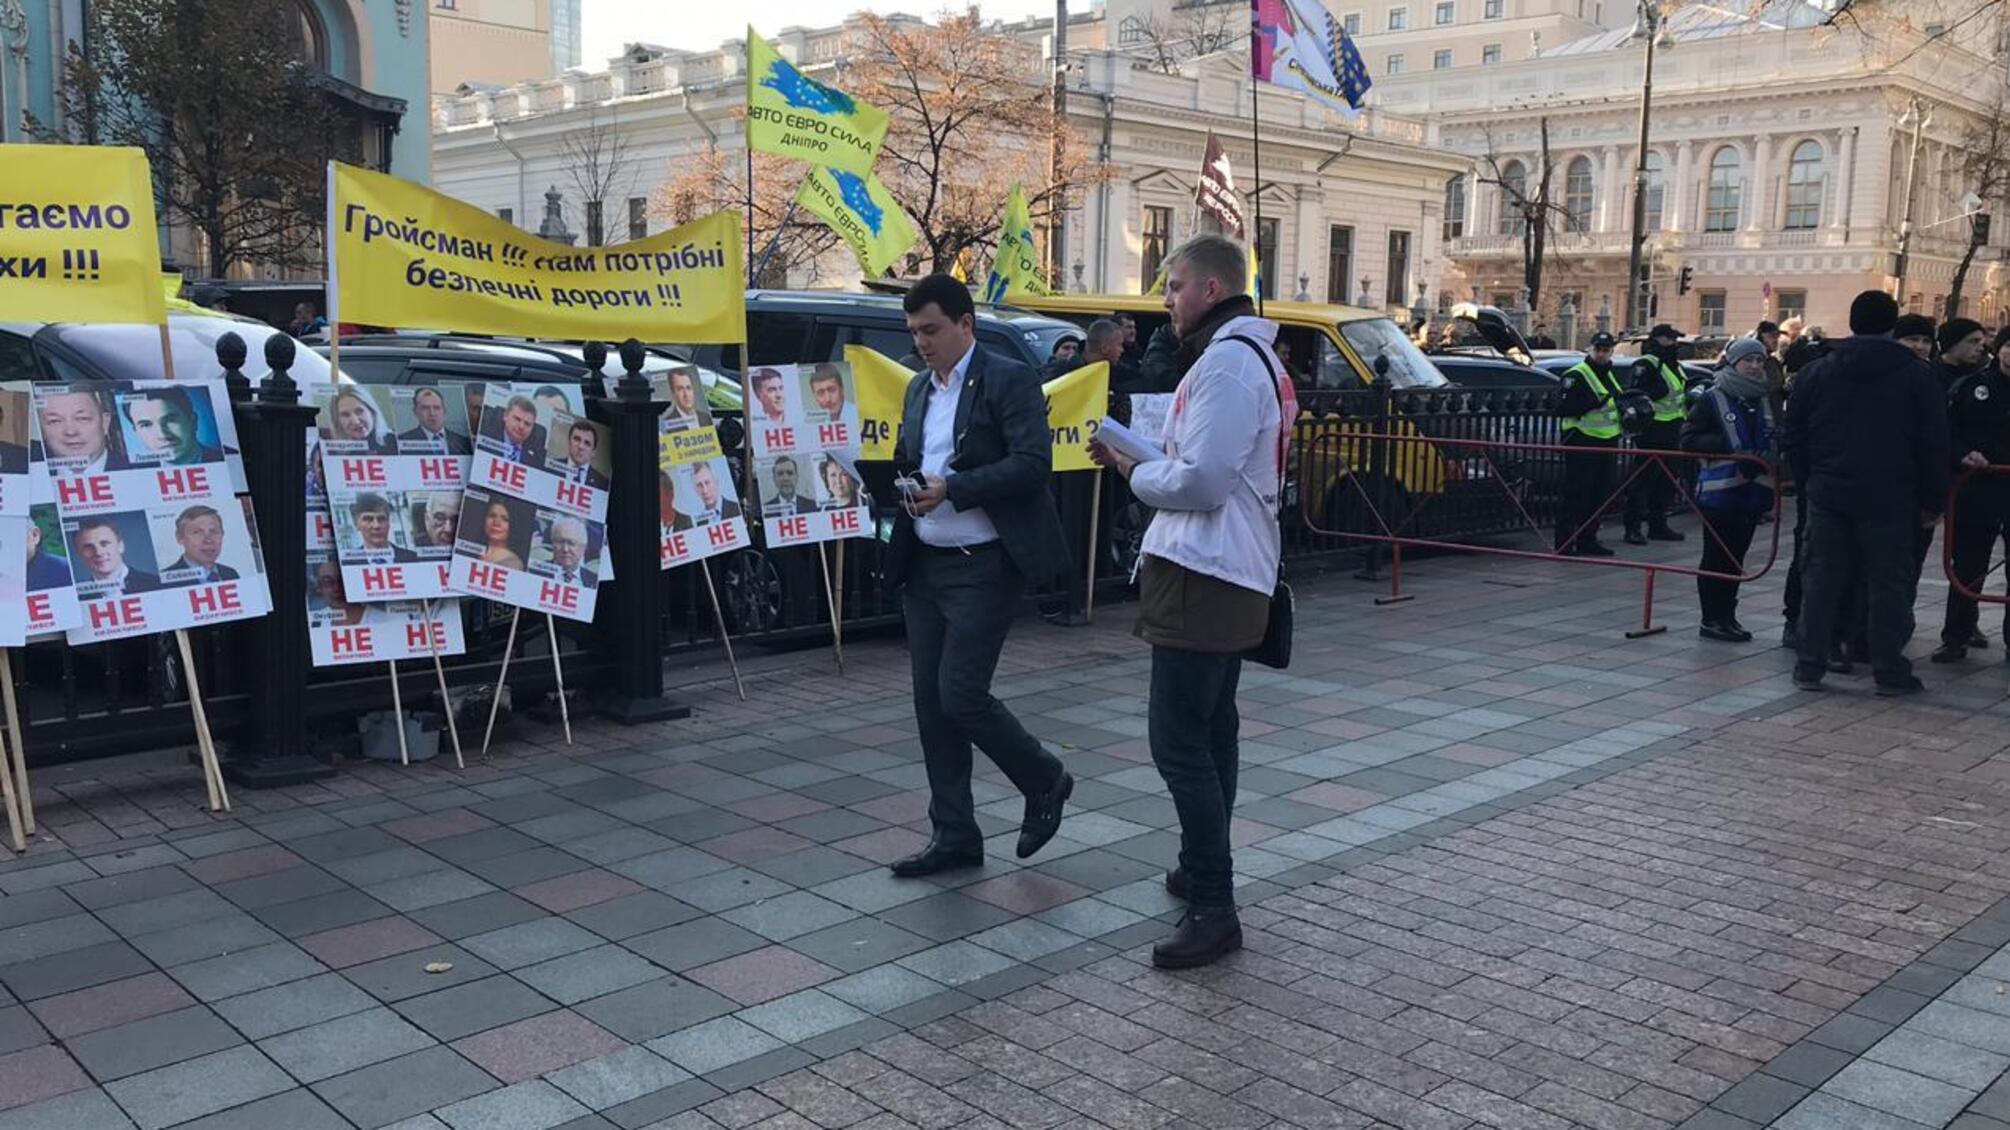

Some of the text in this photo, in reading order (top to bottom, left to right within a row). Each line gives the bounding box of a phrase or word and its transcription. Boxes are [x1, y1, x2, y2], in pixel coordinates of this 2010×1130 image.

[780, 132, 829, 152] ДНІПРО
[786, 114, 827, 135] ЄВРО
[830, 125, 872, 155] СИЛА
[345, 203, 493, 264] Гройсман
[502, 243, 528, 268] !!!
[605, 241, 724, 276] потрібні
[0, 249, 99, 279] хи !!!
[406, 258, 682, 311] безпечні дороги !!!
[673, 433, 713, 449] Разом
[765, 423, 849, 448] НЕ НЕ
[861, 419, 889, 444] де
[342, 458, 461, 481] НЕ НЕ
[488, 457, 528, 489] НЕ
[557, 479, 593, 509] НЕ
[58, 467, 210, 504] НЕ НЕ
[779, 511, 860, 537] НЕ НЕ
[660, 534, 688, 560] НЕ
[706, 522, 737, 545] НЕ
[362, 567, 405, 590] НЕ
[468, 562, 508, 592] НЕ
[540, 581, 579, 609] НЕ
[88, 583, 241, 629] НЕ НЕ
[331, 622, 446, 653] НЕ НЕ
